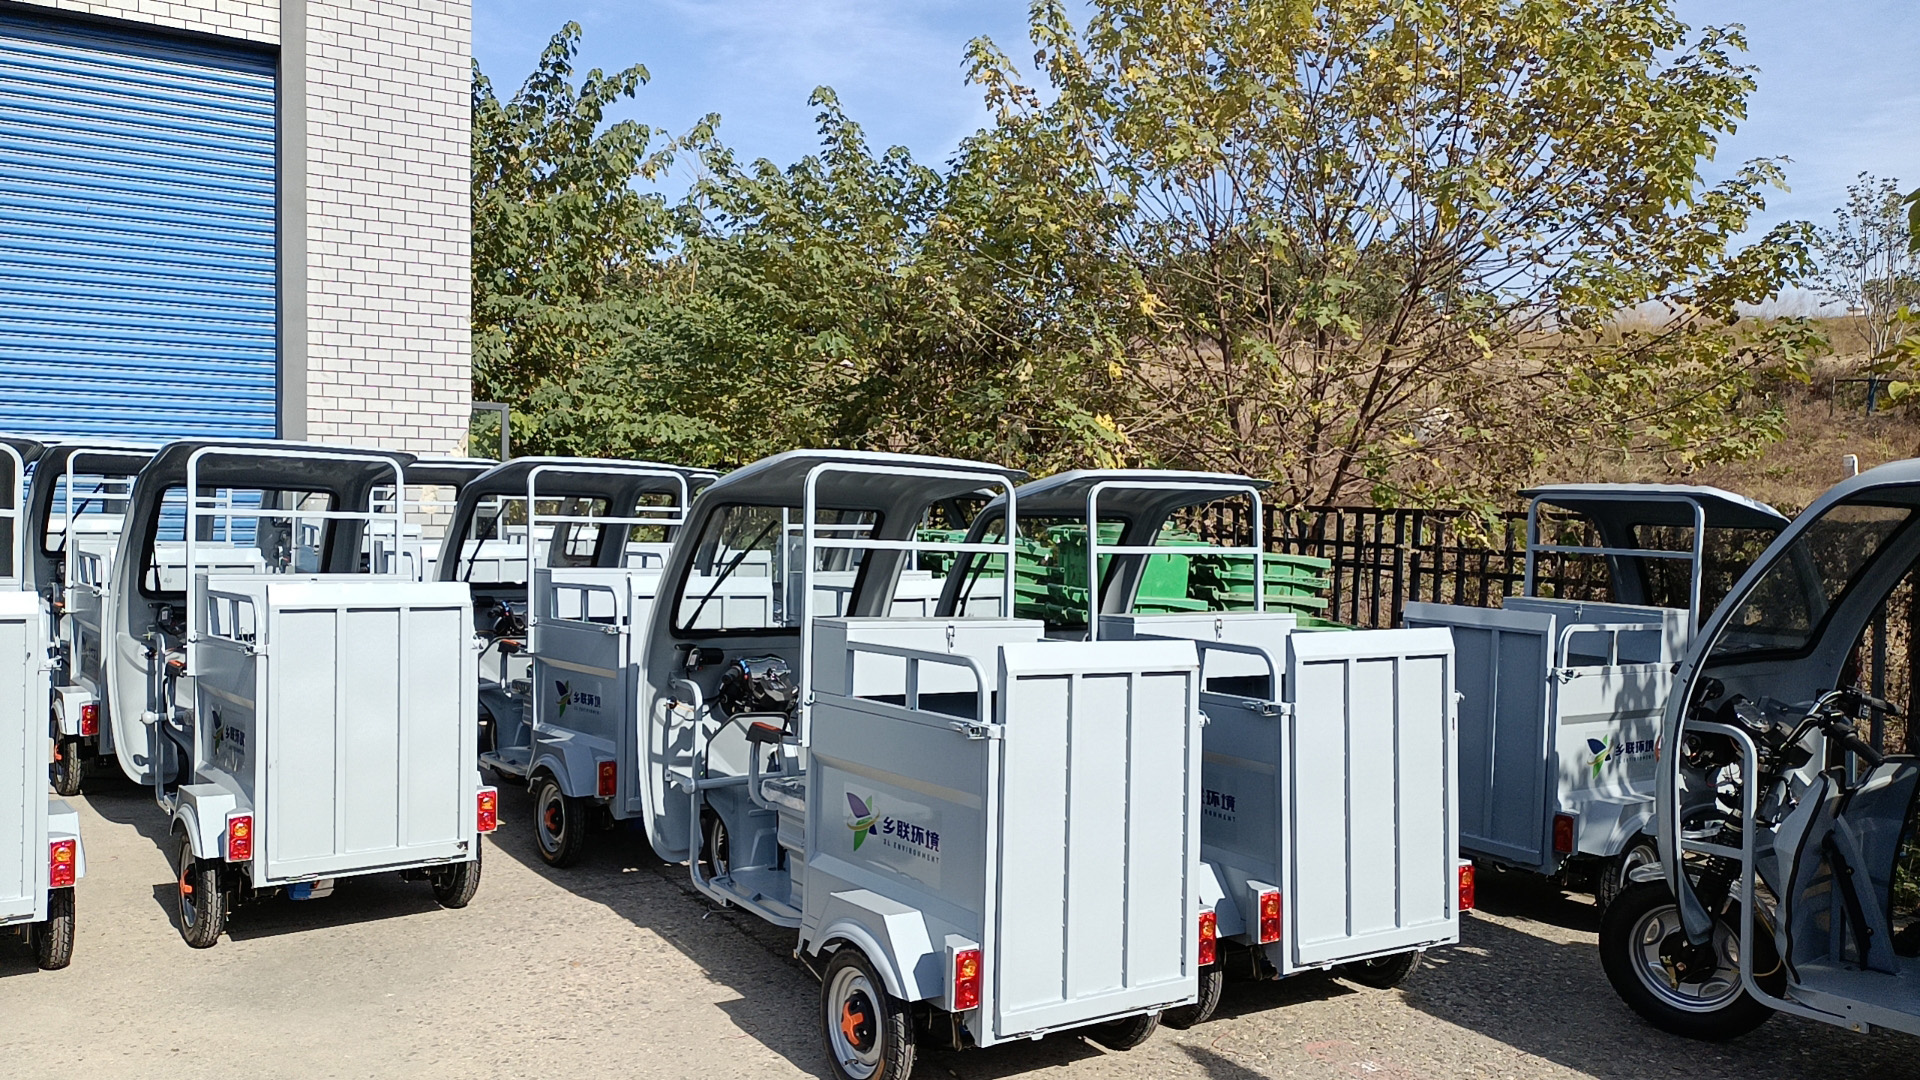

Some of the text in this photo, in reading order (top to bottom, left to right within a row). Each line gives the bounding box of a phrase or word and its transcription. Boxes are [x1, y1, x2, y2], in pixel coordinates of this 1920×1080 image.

[1201, 788, 1235, 812] 环境
[883, 816, 940, 852] 乡联环境
[893, 842, 940, 864] ENVIRONMENT
